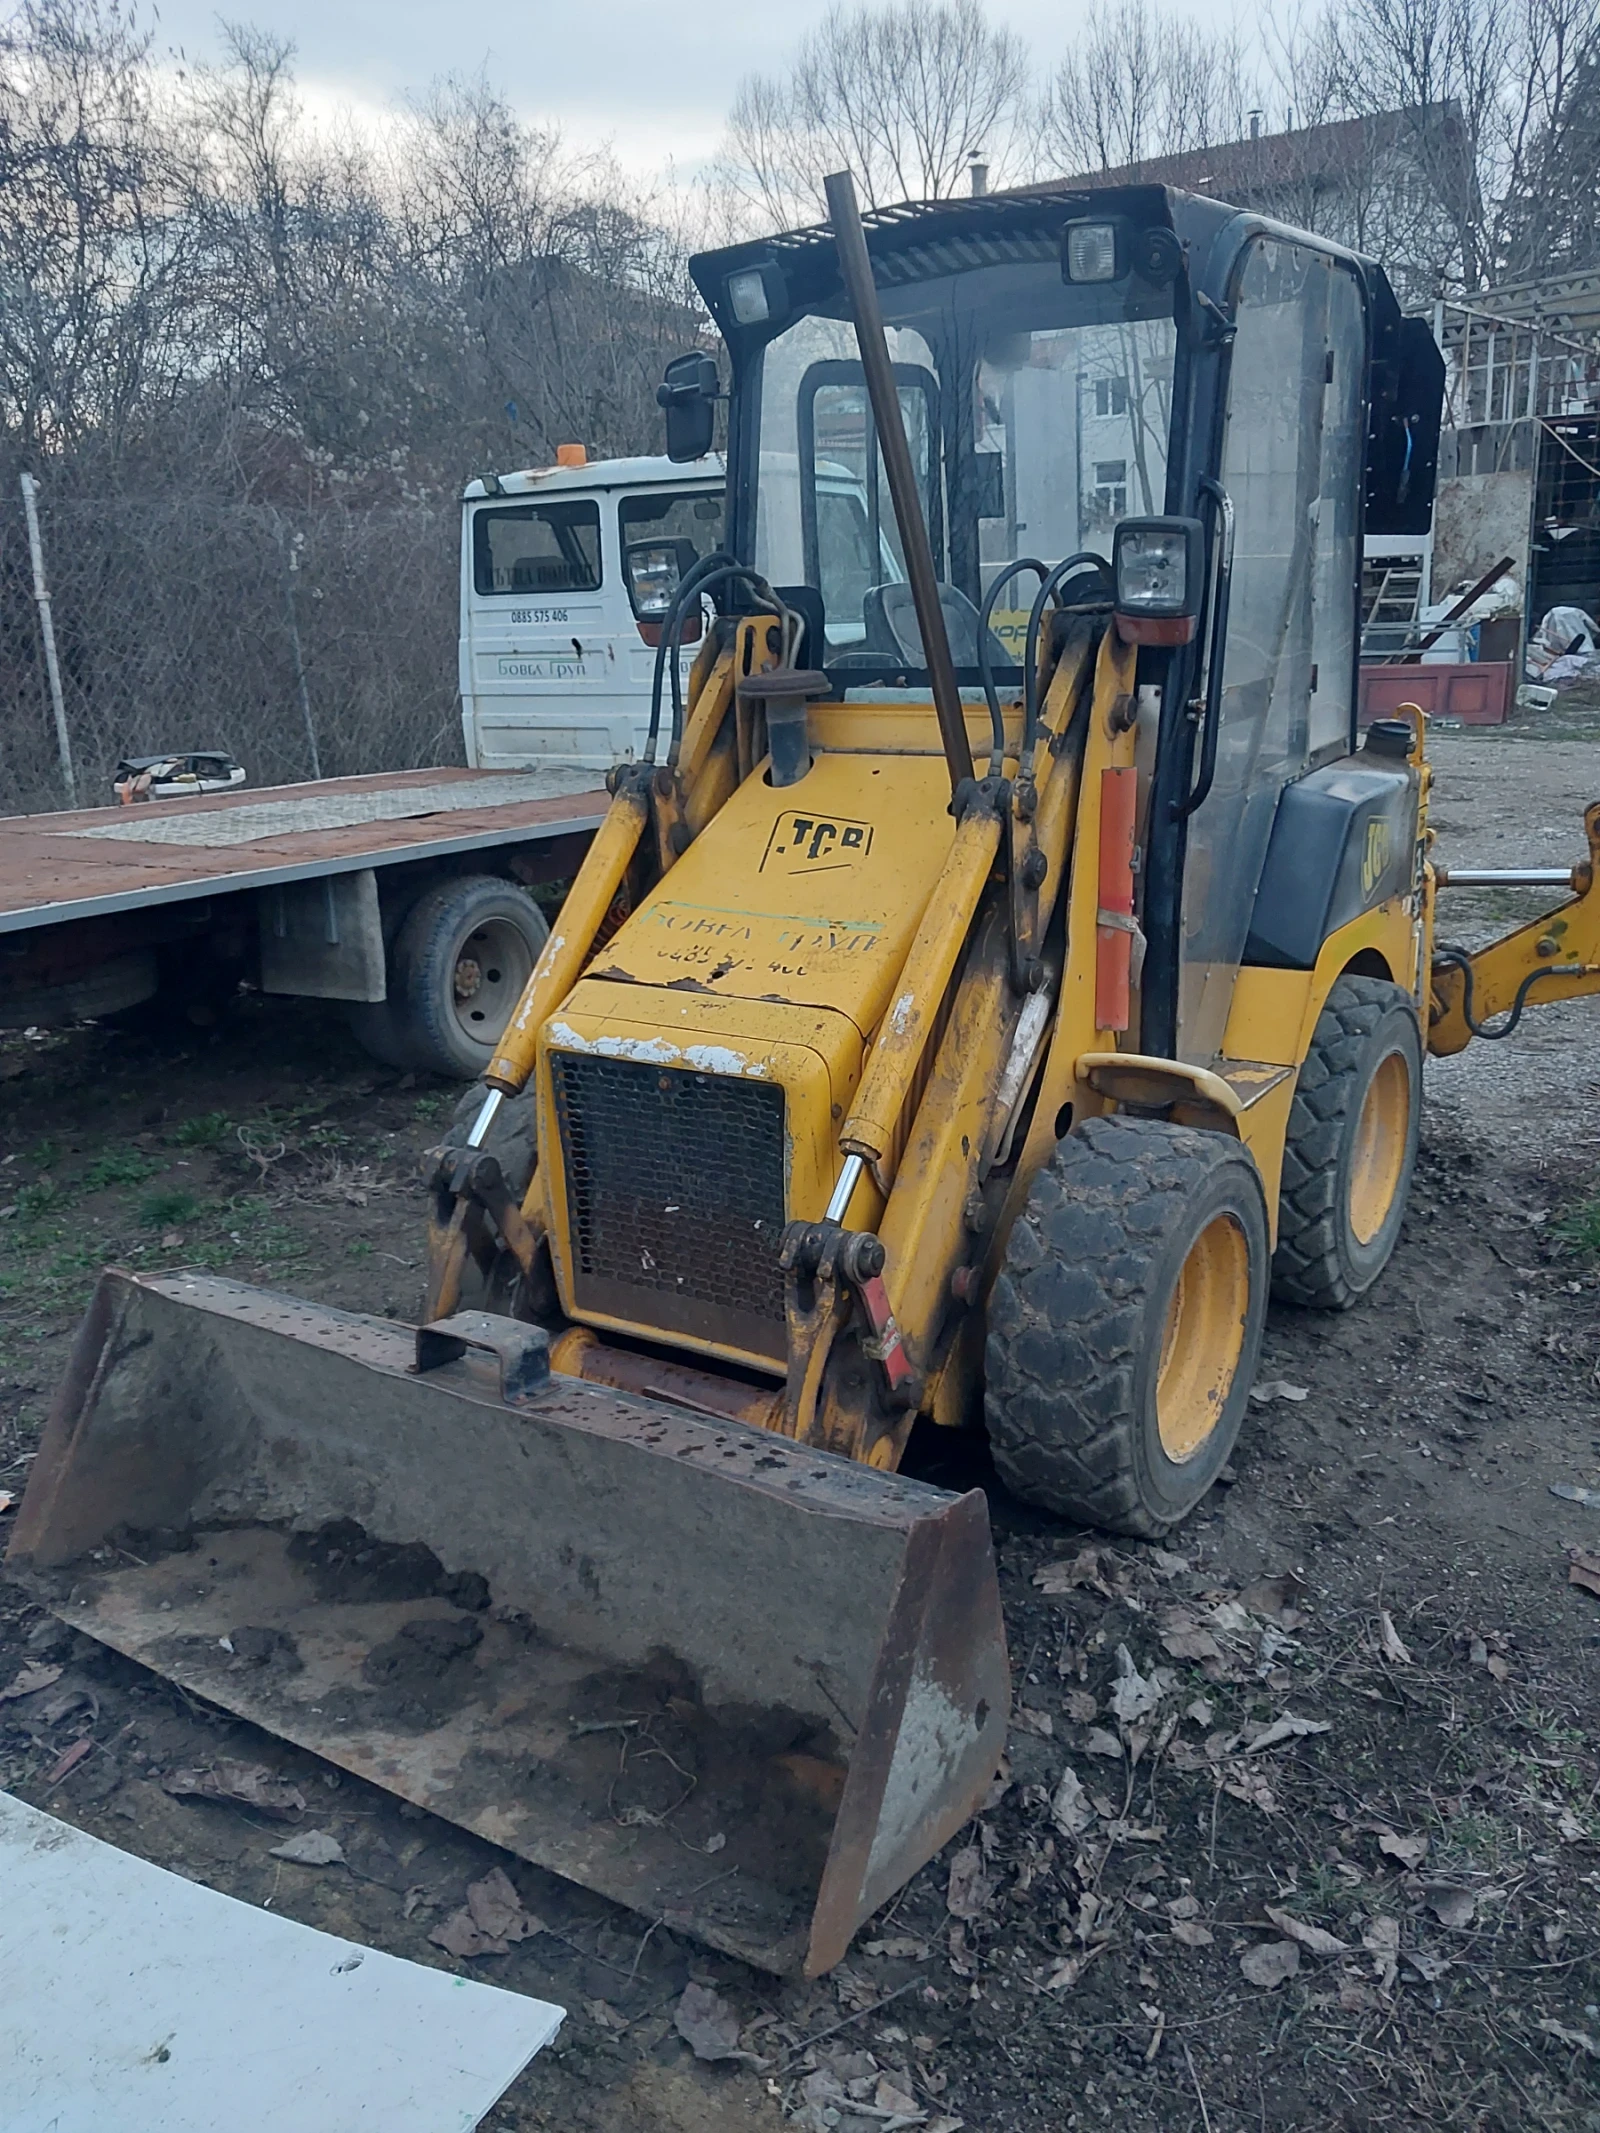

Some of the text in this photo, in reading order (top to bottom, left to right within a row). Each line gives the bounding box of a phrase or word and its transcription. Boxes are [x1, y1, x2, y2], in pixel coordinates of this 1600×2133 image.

[511, 608, 568, 624] 0885 575 406
